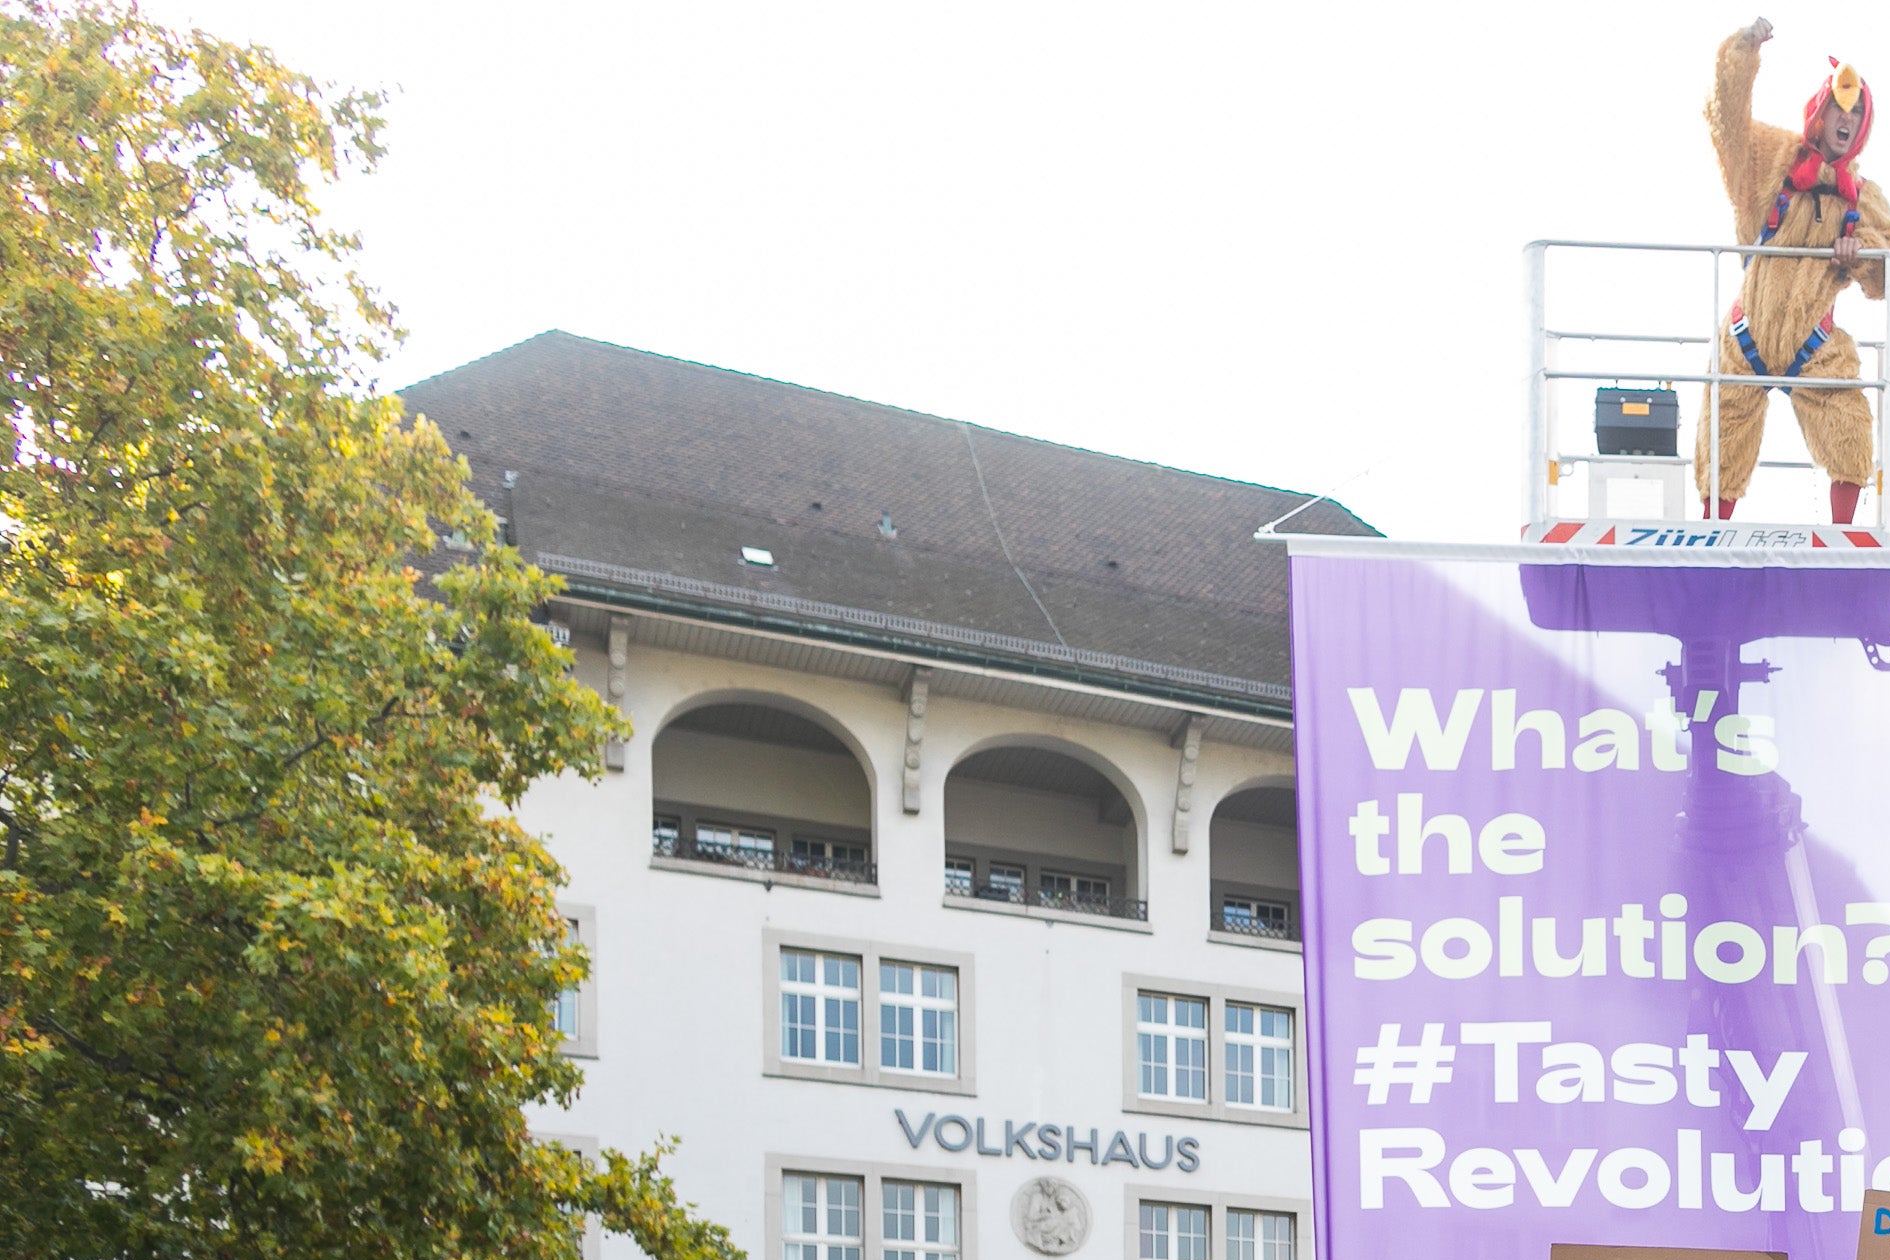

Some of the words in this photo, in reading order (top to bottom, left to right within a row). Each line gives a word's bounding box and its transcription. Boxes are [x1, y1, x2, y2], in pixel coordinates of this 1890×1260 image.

[1346, 687, 1780, 777] What's
[1348, 793, 1547, 877] the
[1352, 1021, 1809, 1132] #Tasty
[895, 1108, 1200, 1173] VOLKSHAUS
